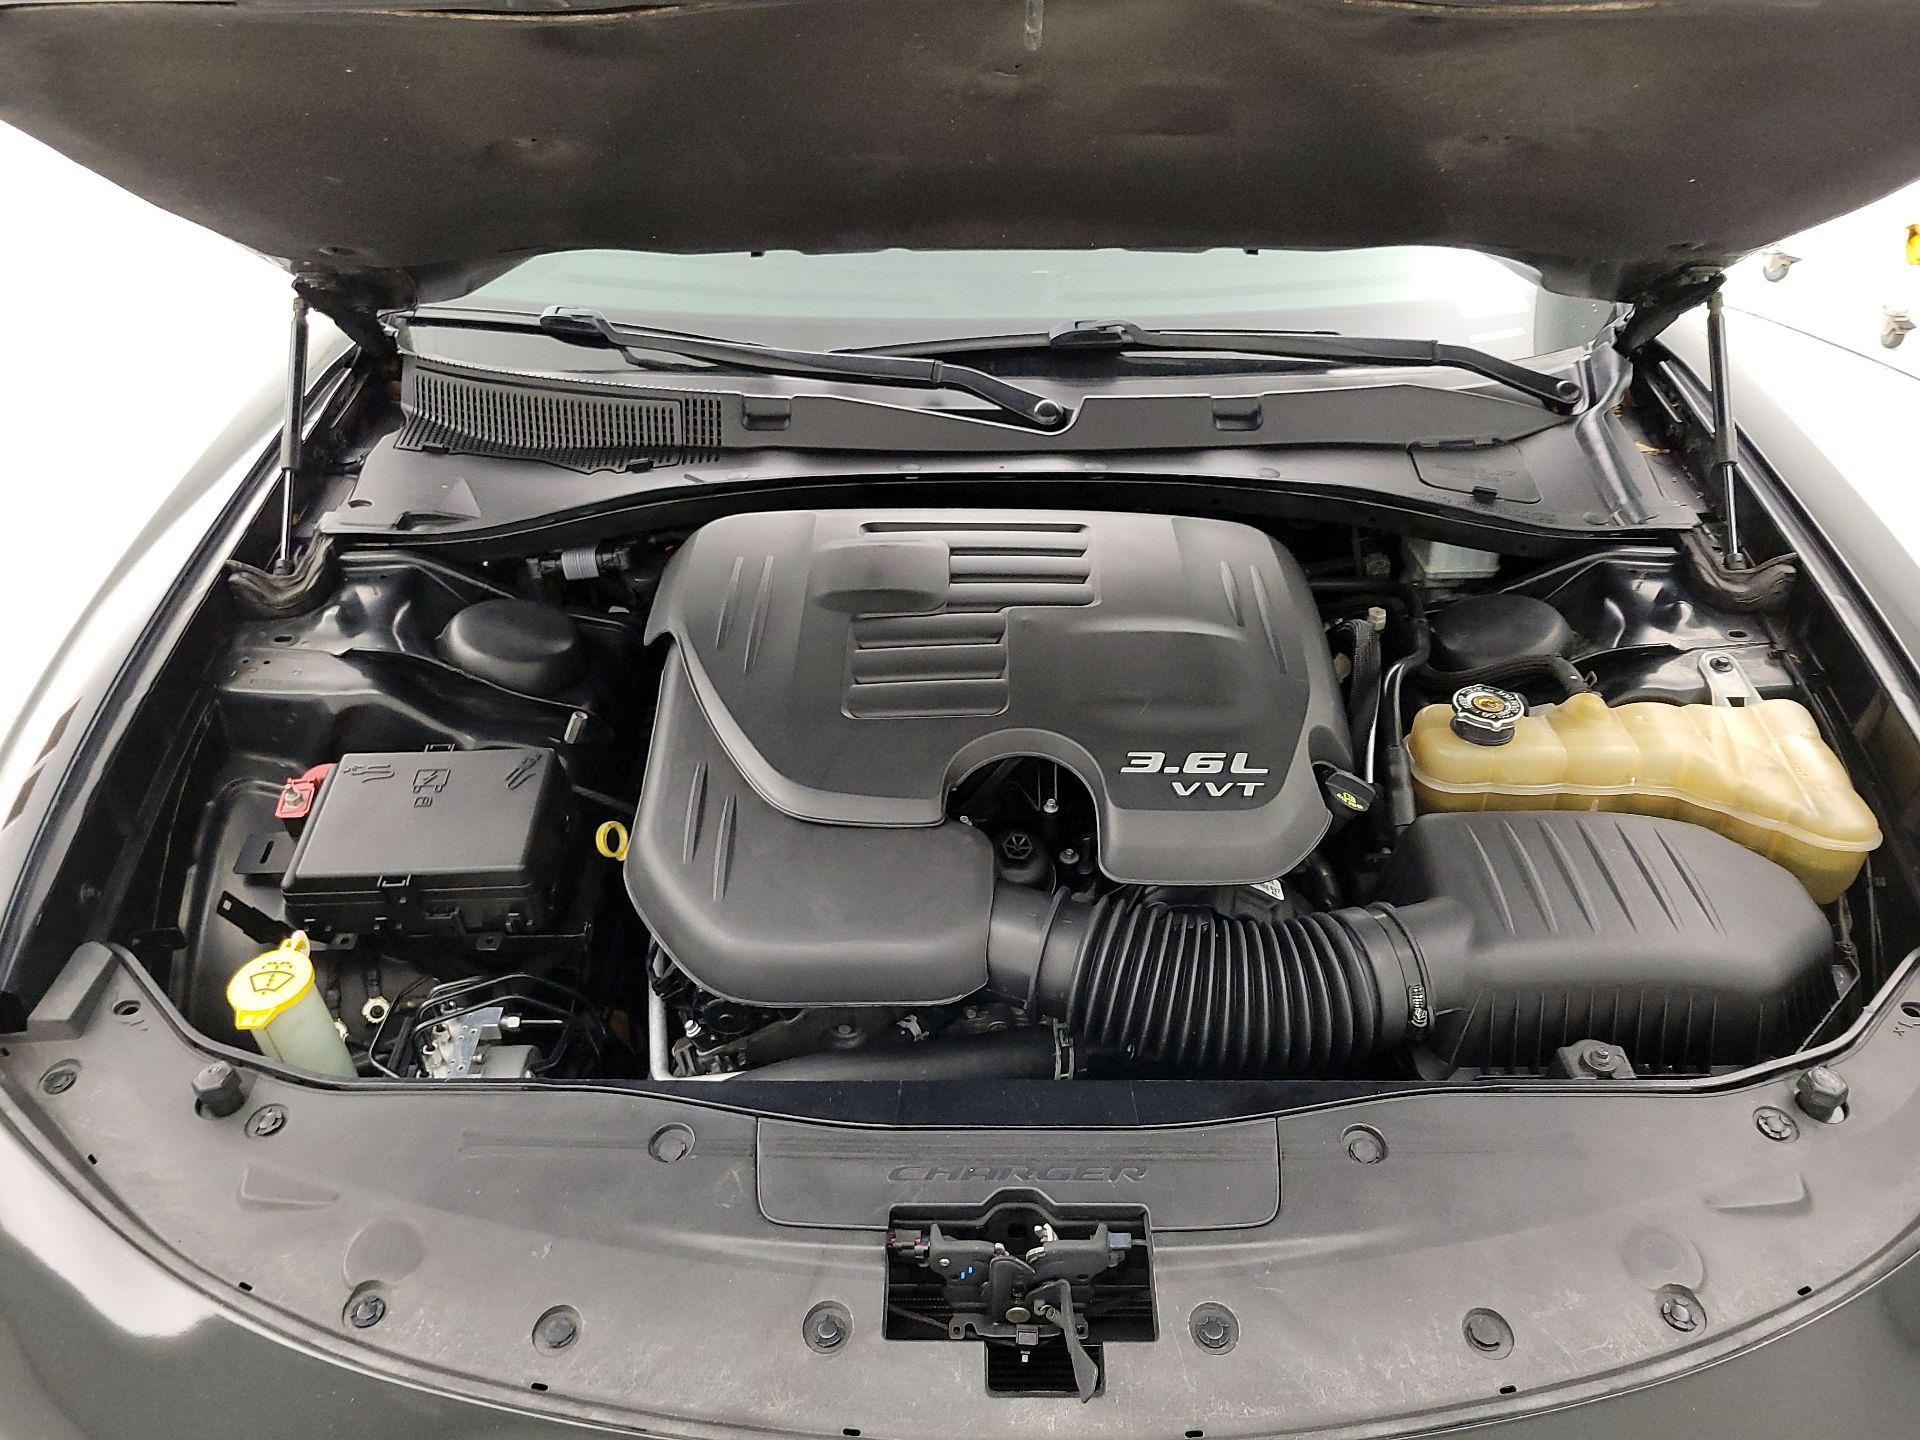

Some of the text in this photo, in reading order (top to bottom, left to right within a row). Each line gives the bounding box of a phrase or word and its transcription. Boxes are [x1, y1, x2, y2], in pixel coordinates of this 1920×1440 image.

[1120, 751, 1269, 774] 3.6L
[1171, 781, 1266, 797] VVT
[887, 1166, 1147, 1182] CHARGER
